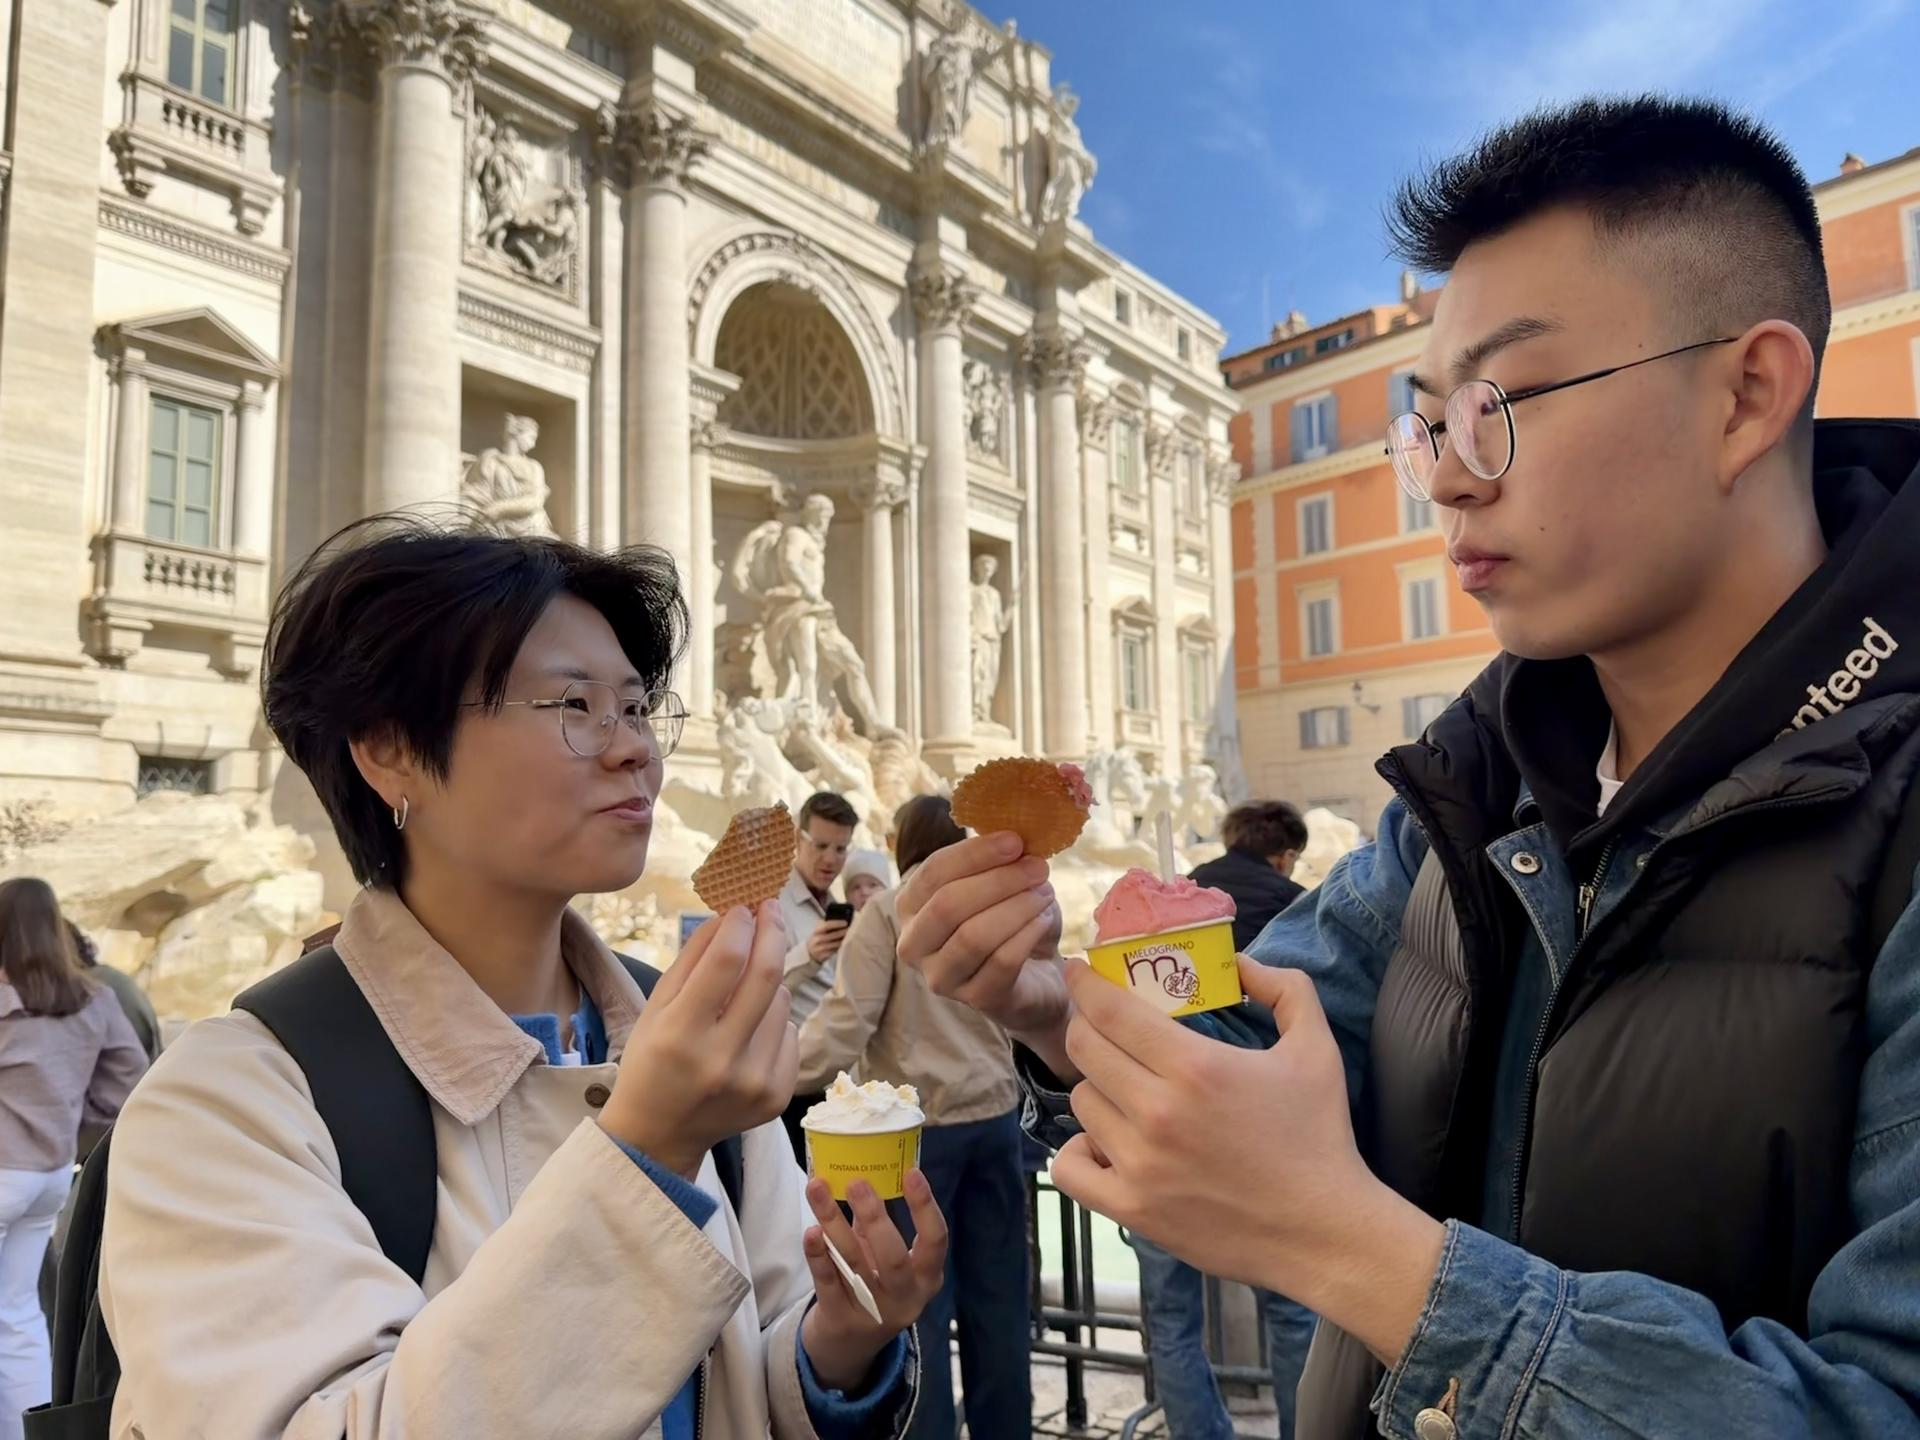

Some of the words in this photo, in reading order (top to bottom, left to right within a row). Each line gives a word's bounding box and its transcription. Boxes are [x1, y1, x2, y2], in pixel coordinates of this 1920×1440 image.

[1774, 616, 1899, 741] nteed
[1128, 940, 1195, 961] MELOGRANO
[829, 1162, 859, 1172] FONTANA
